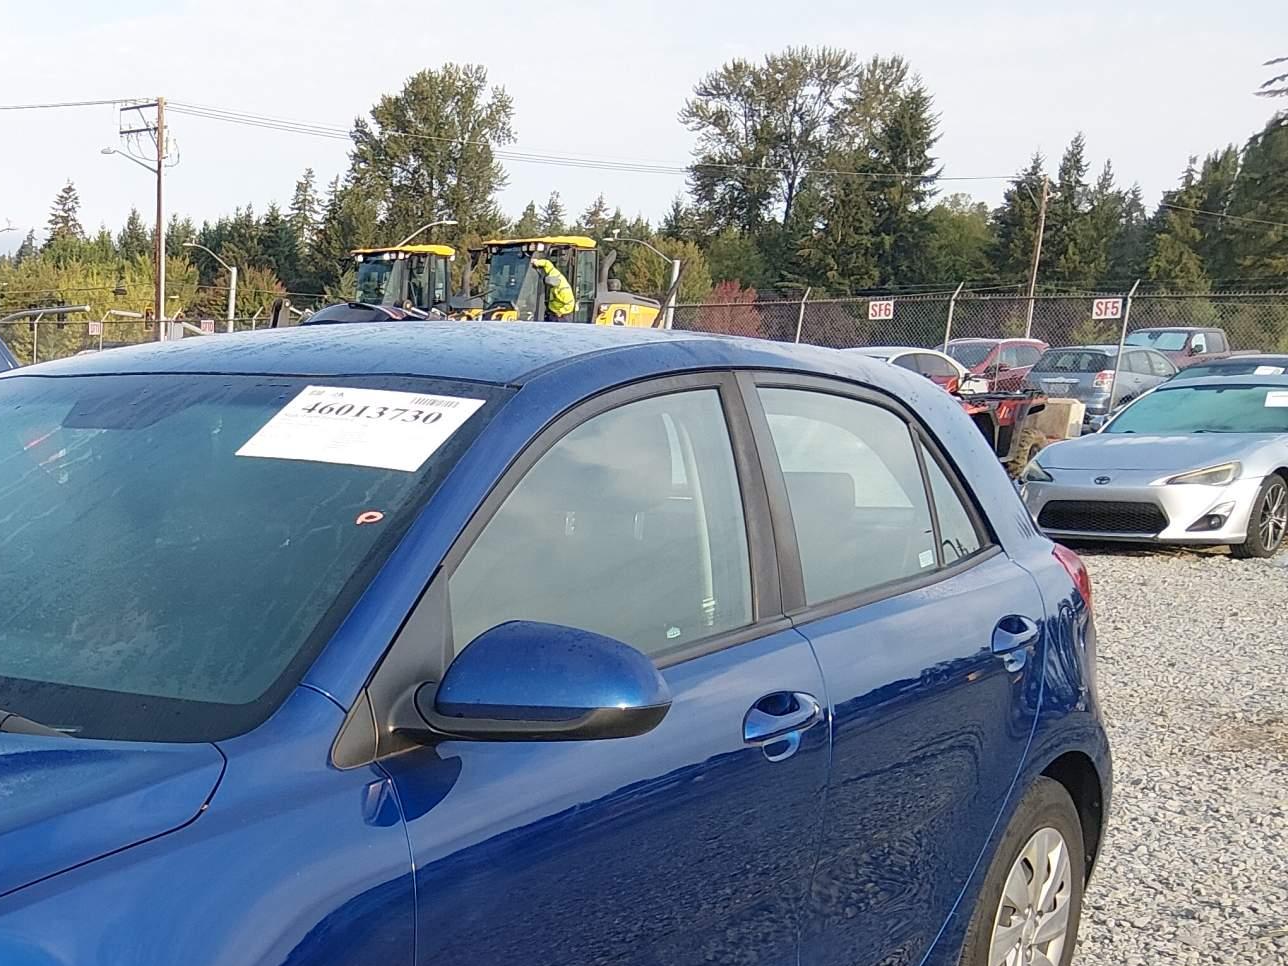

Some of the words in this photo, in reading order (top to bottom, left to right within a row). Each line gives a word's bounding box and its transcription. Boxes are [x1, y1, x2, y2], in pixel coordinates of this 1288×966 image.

[871, 303, 891, 317] SF6
[1095, 301, 1120, 316] SF5
[301, 401, 443, 425] 46013730
